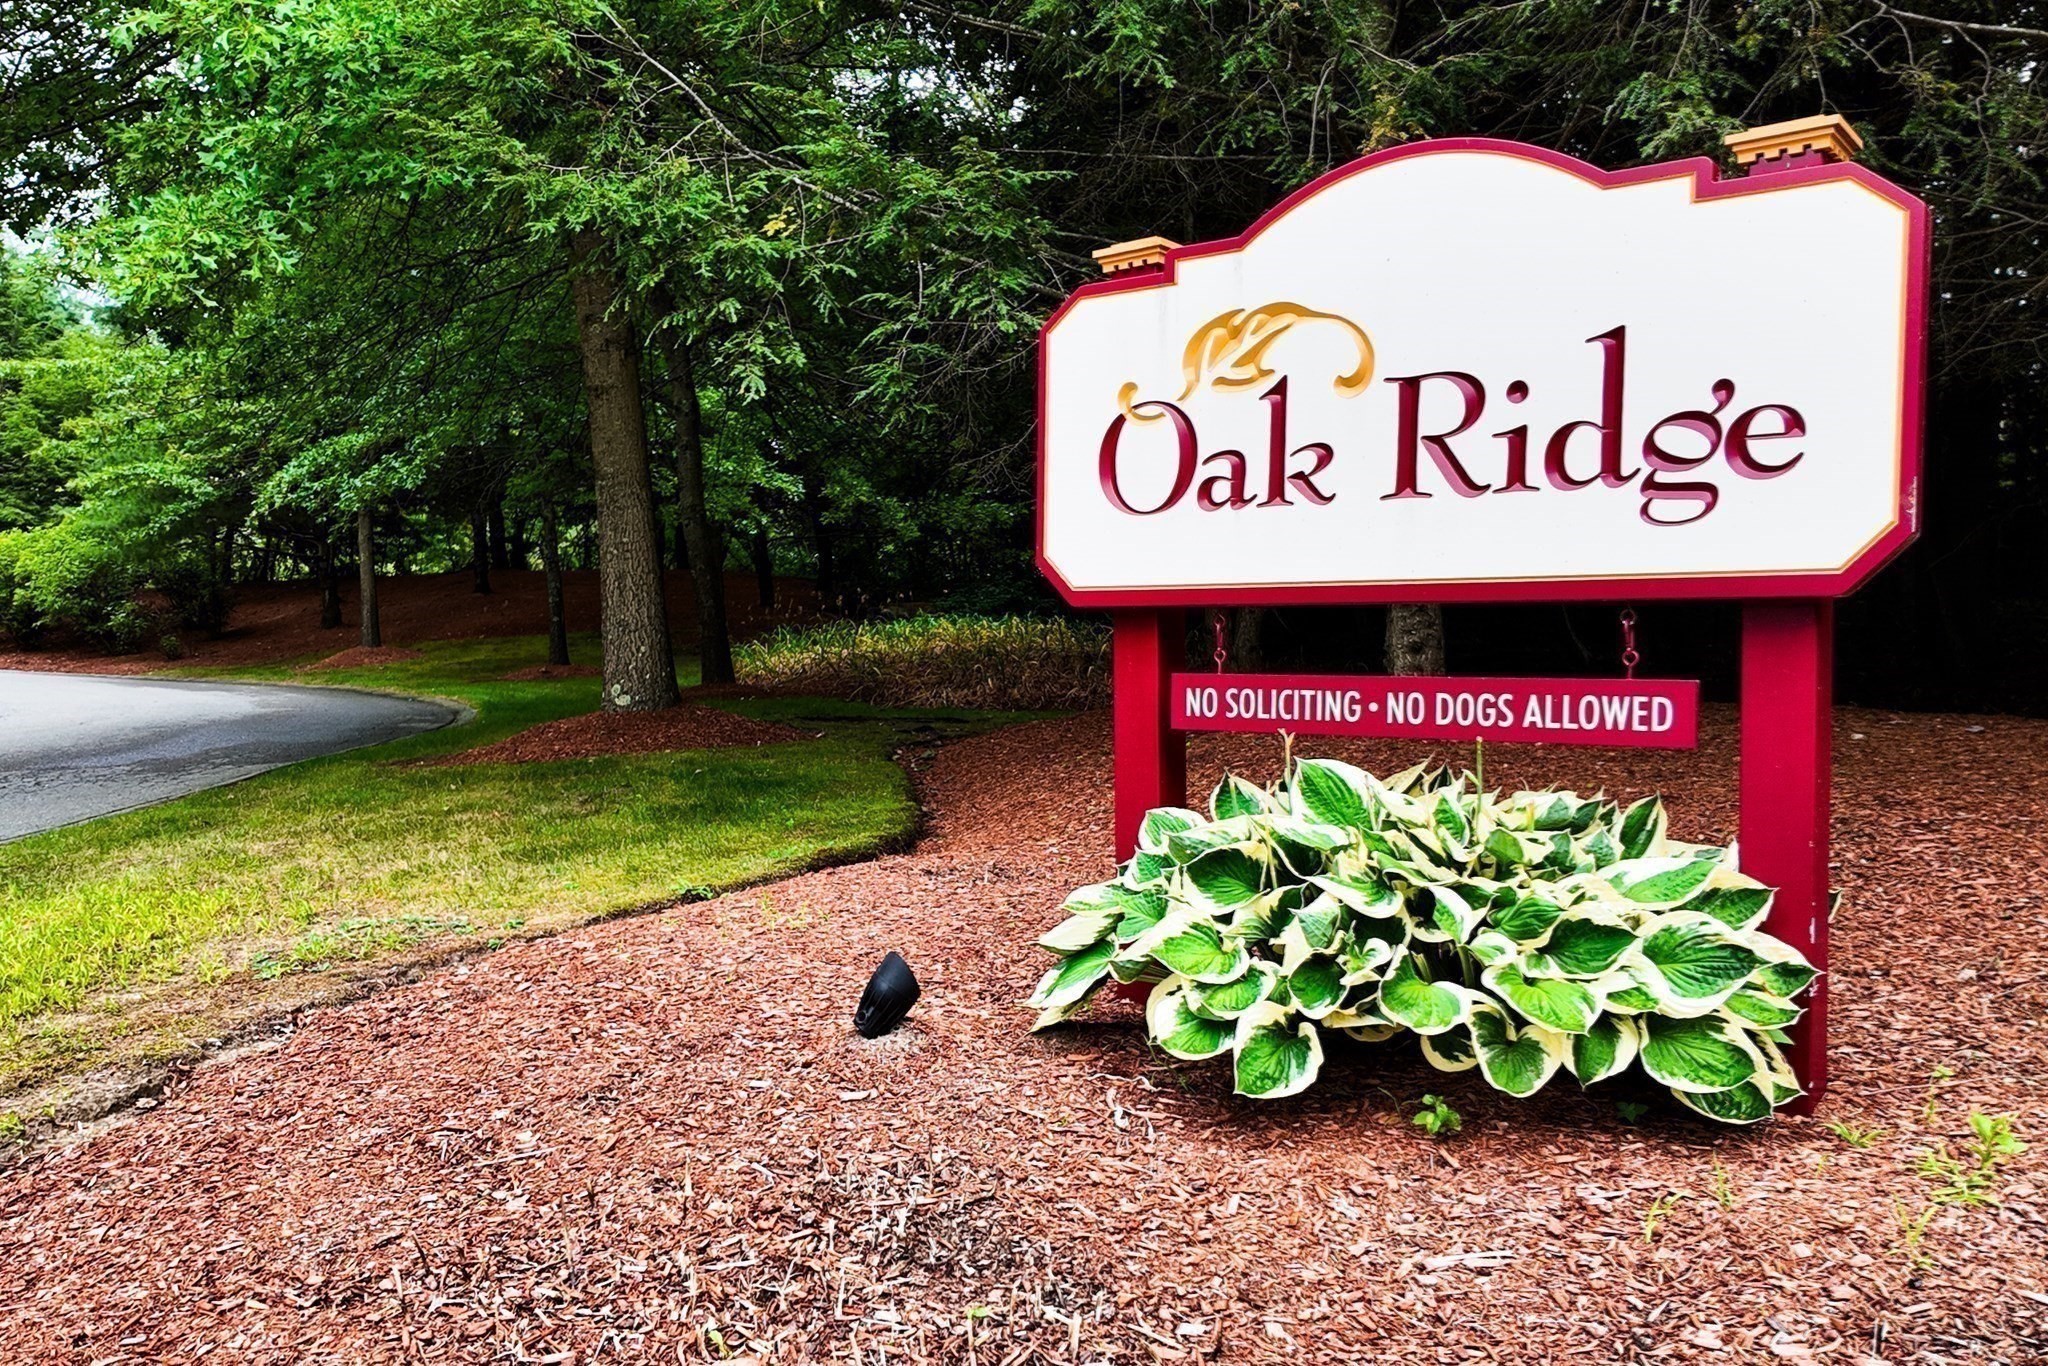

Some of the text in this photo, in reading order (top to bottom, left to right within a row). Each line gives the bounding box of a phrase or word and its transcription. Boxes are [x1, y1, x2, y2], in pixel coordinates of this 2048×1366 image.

[1098, 324, 1807, 527] Oak Ridge
[1185, 686, 1674, 732] NO SOLICITING NO DOGS ALLOWED
